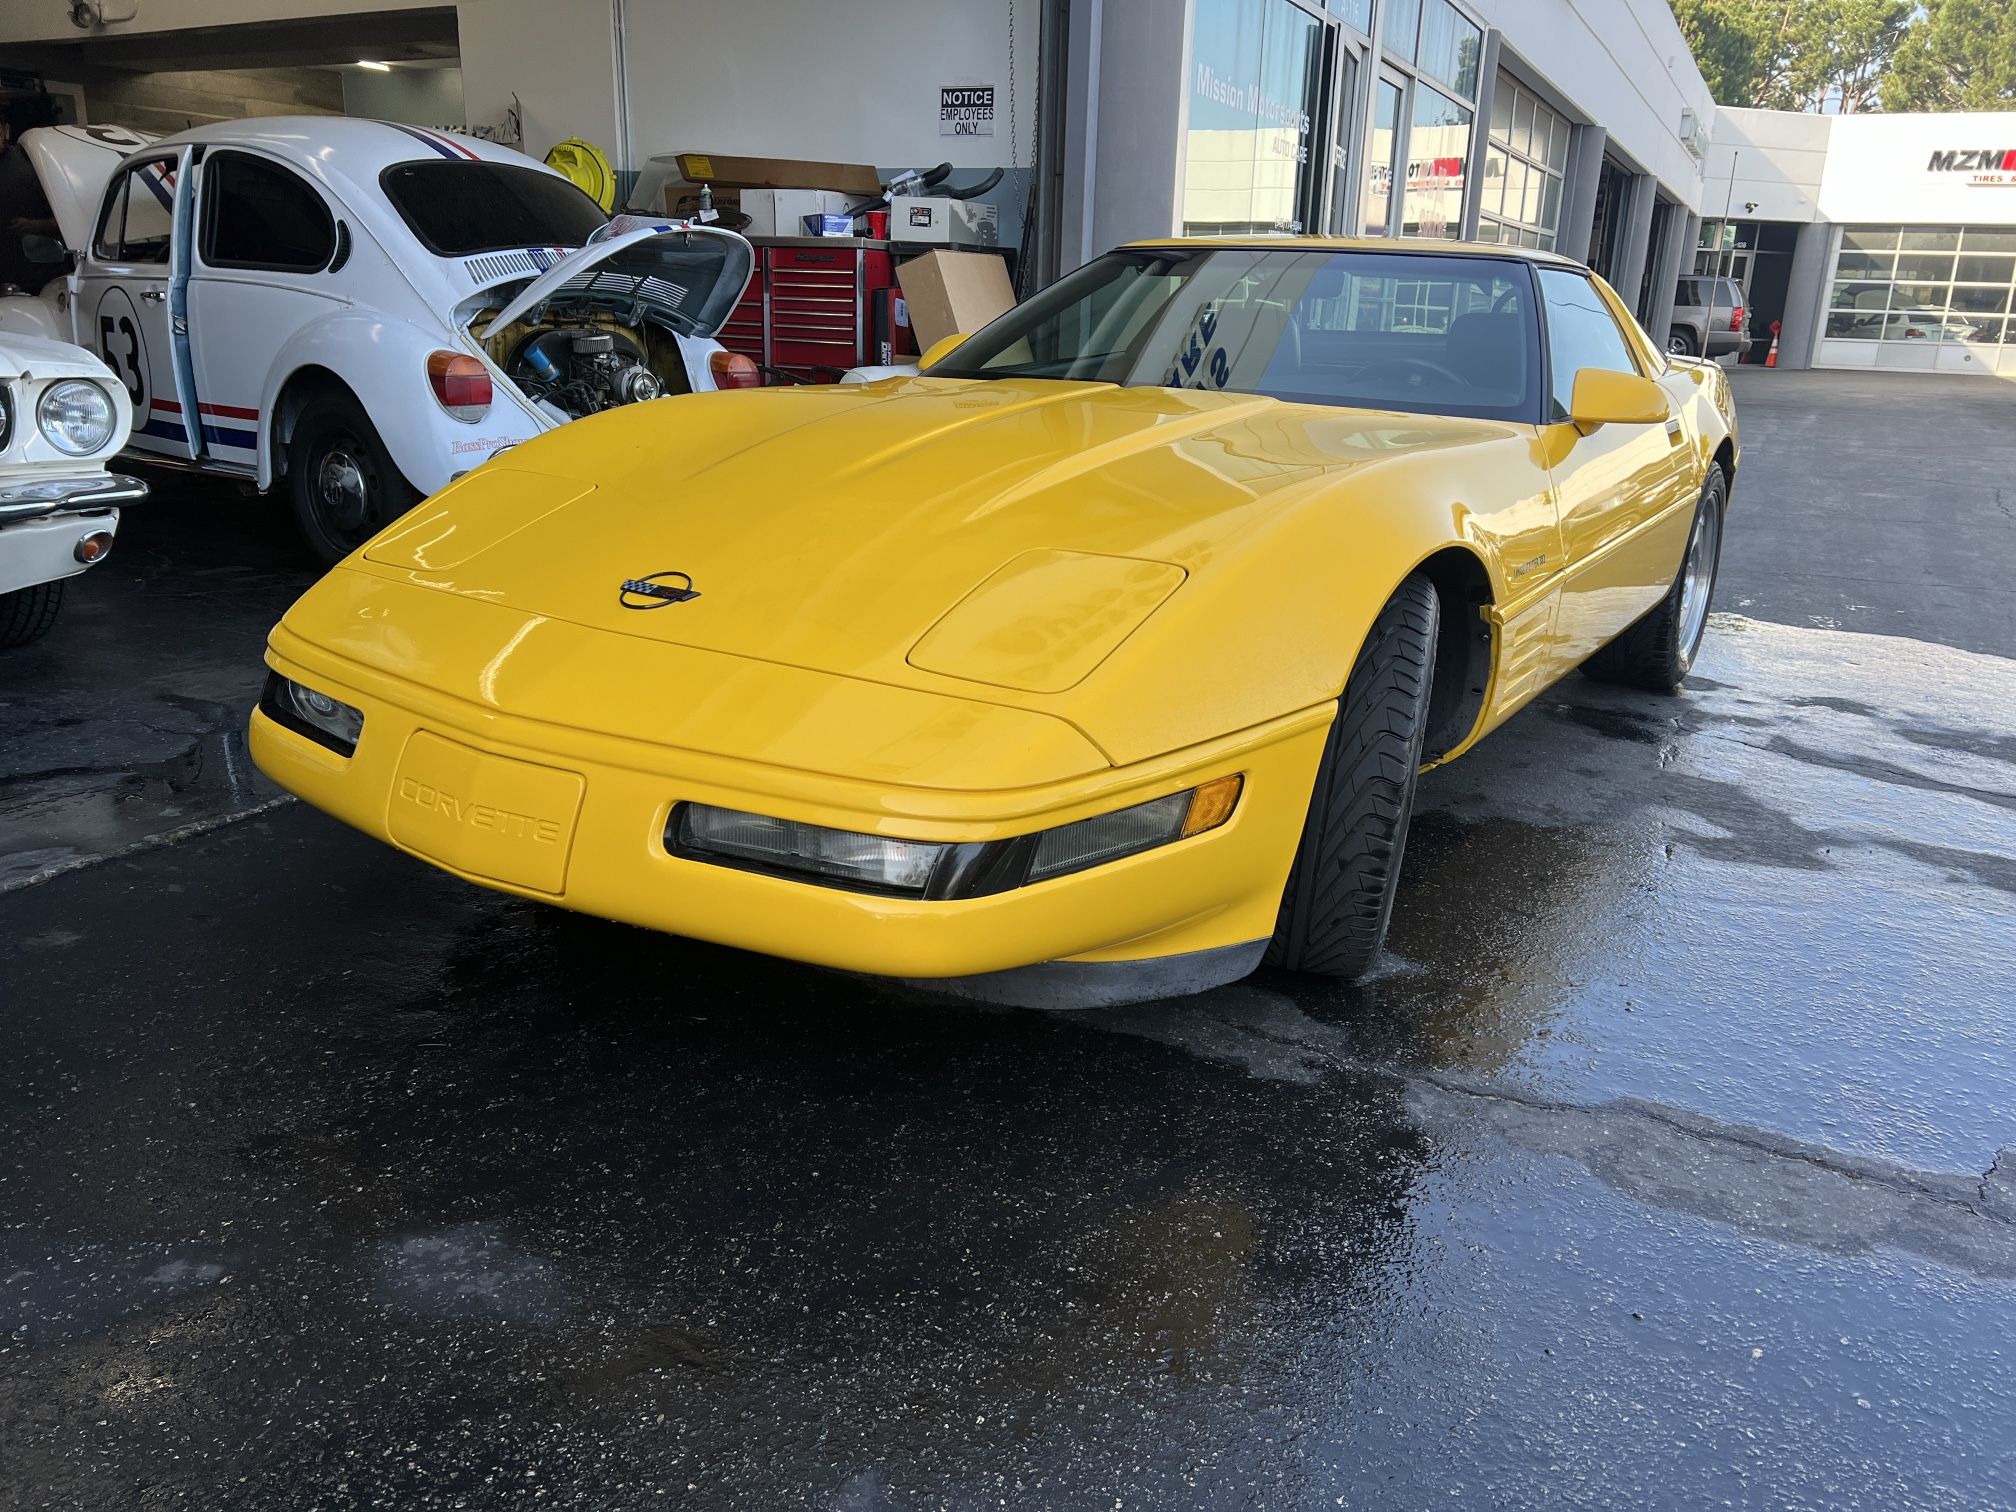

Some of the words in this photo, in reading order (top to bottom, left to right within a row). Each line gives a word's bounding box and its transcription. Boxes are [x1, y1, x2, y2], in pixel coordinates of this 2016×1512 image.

[943, 91, 992, 105] NOTICE
[1196, 63, 1243, 111] Mission
[1247, 83, 1310, 135] Motorsports
[941, 107, 994, 121] EMPLOYEES
[954, 121, 978, 135] ONLY
[1272, 136, 1290, 158] AUTO
[1927, 149, 2006, 172] MZM
[1973, 175, 2004, 183] TIRES
[100, 315, 145, 407] 53
[400, 776, 561, 845] CORVETTE
